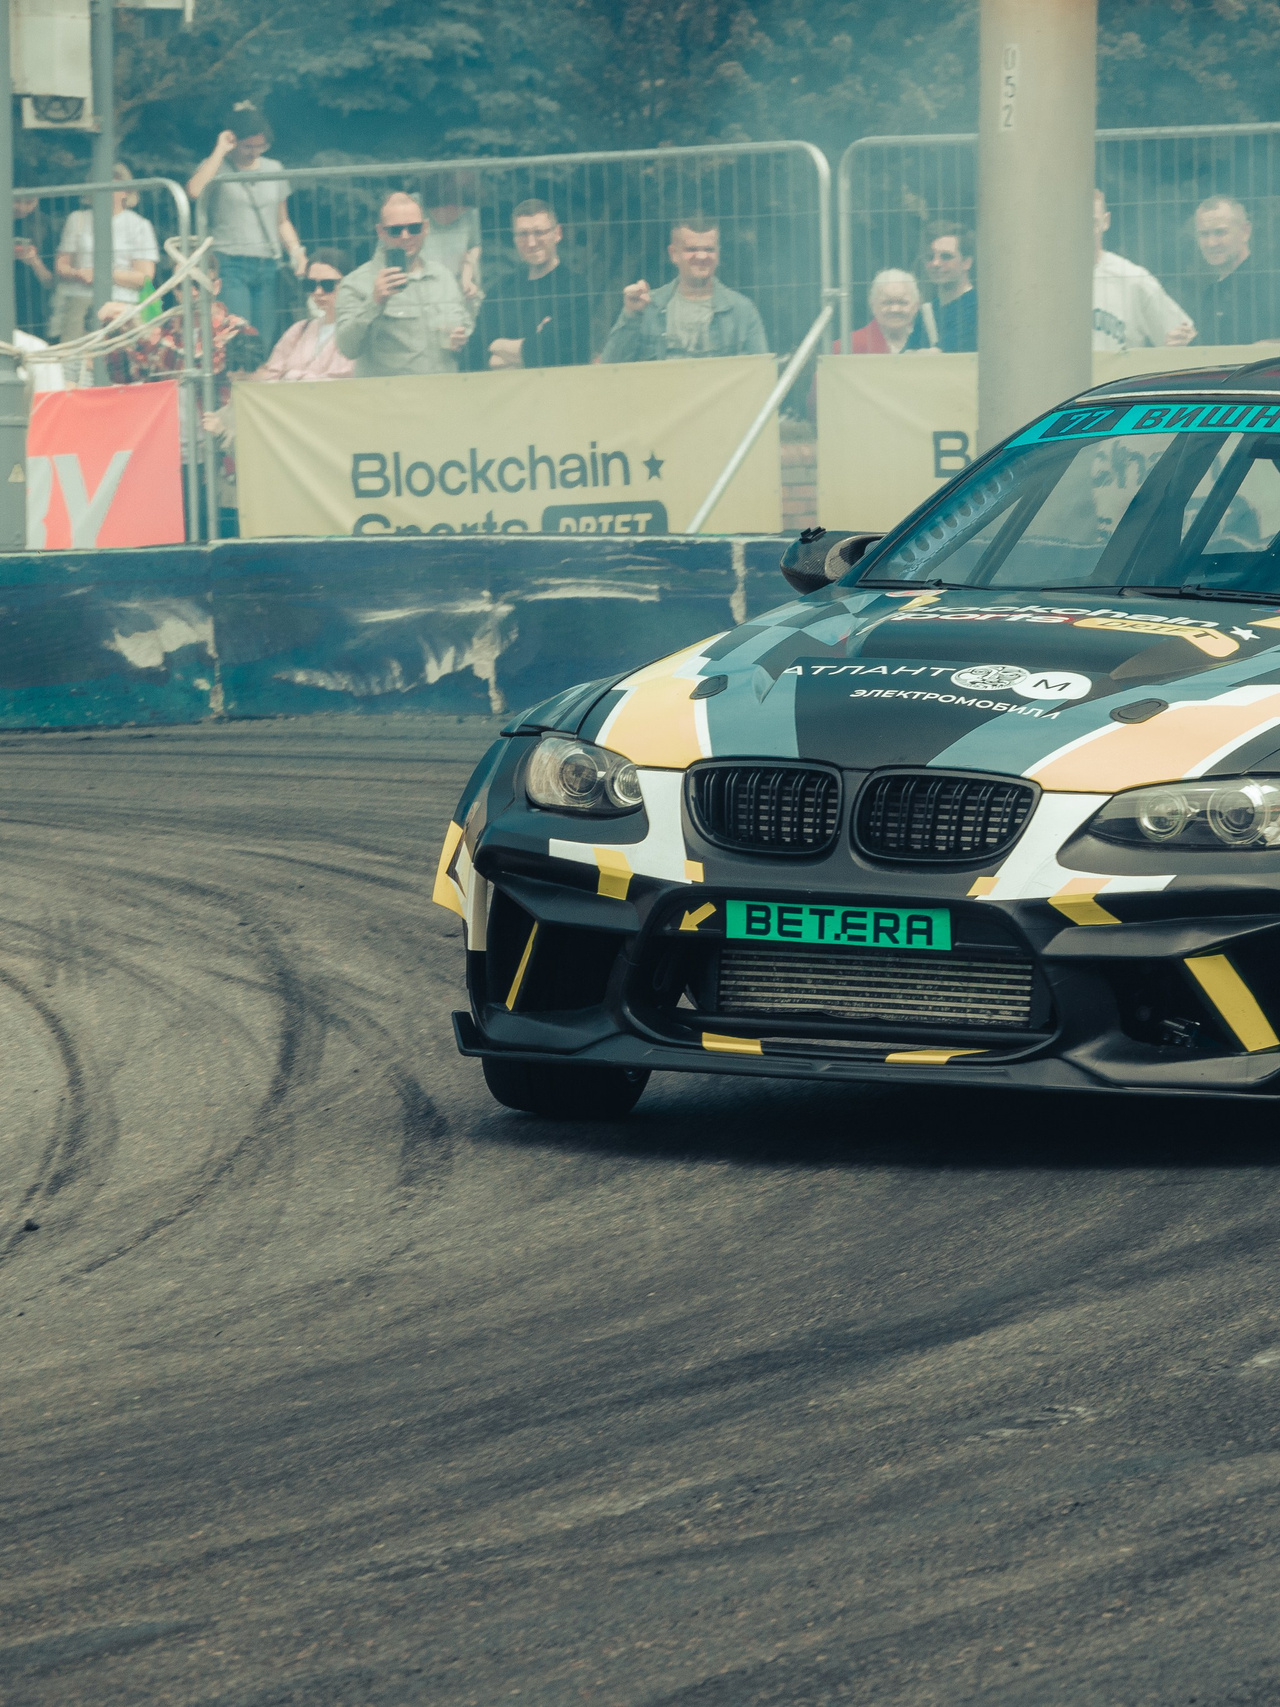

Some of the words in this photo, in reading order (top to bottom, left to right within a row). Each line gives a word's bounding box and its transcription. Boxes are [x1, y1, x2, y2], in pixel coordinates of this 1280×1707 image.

[1059, 409, 1115, 434] 77
[352, 442, 631, 498] Blockchain
[906, 603, 1220, 628] lockchain
[1097, 619, 1219, 641] DRIFT
[780, 666, 957, 679] АТЛАНТ
